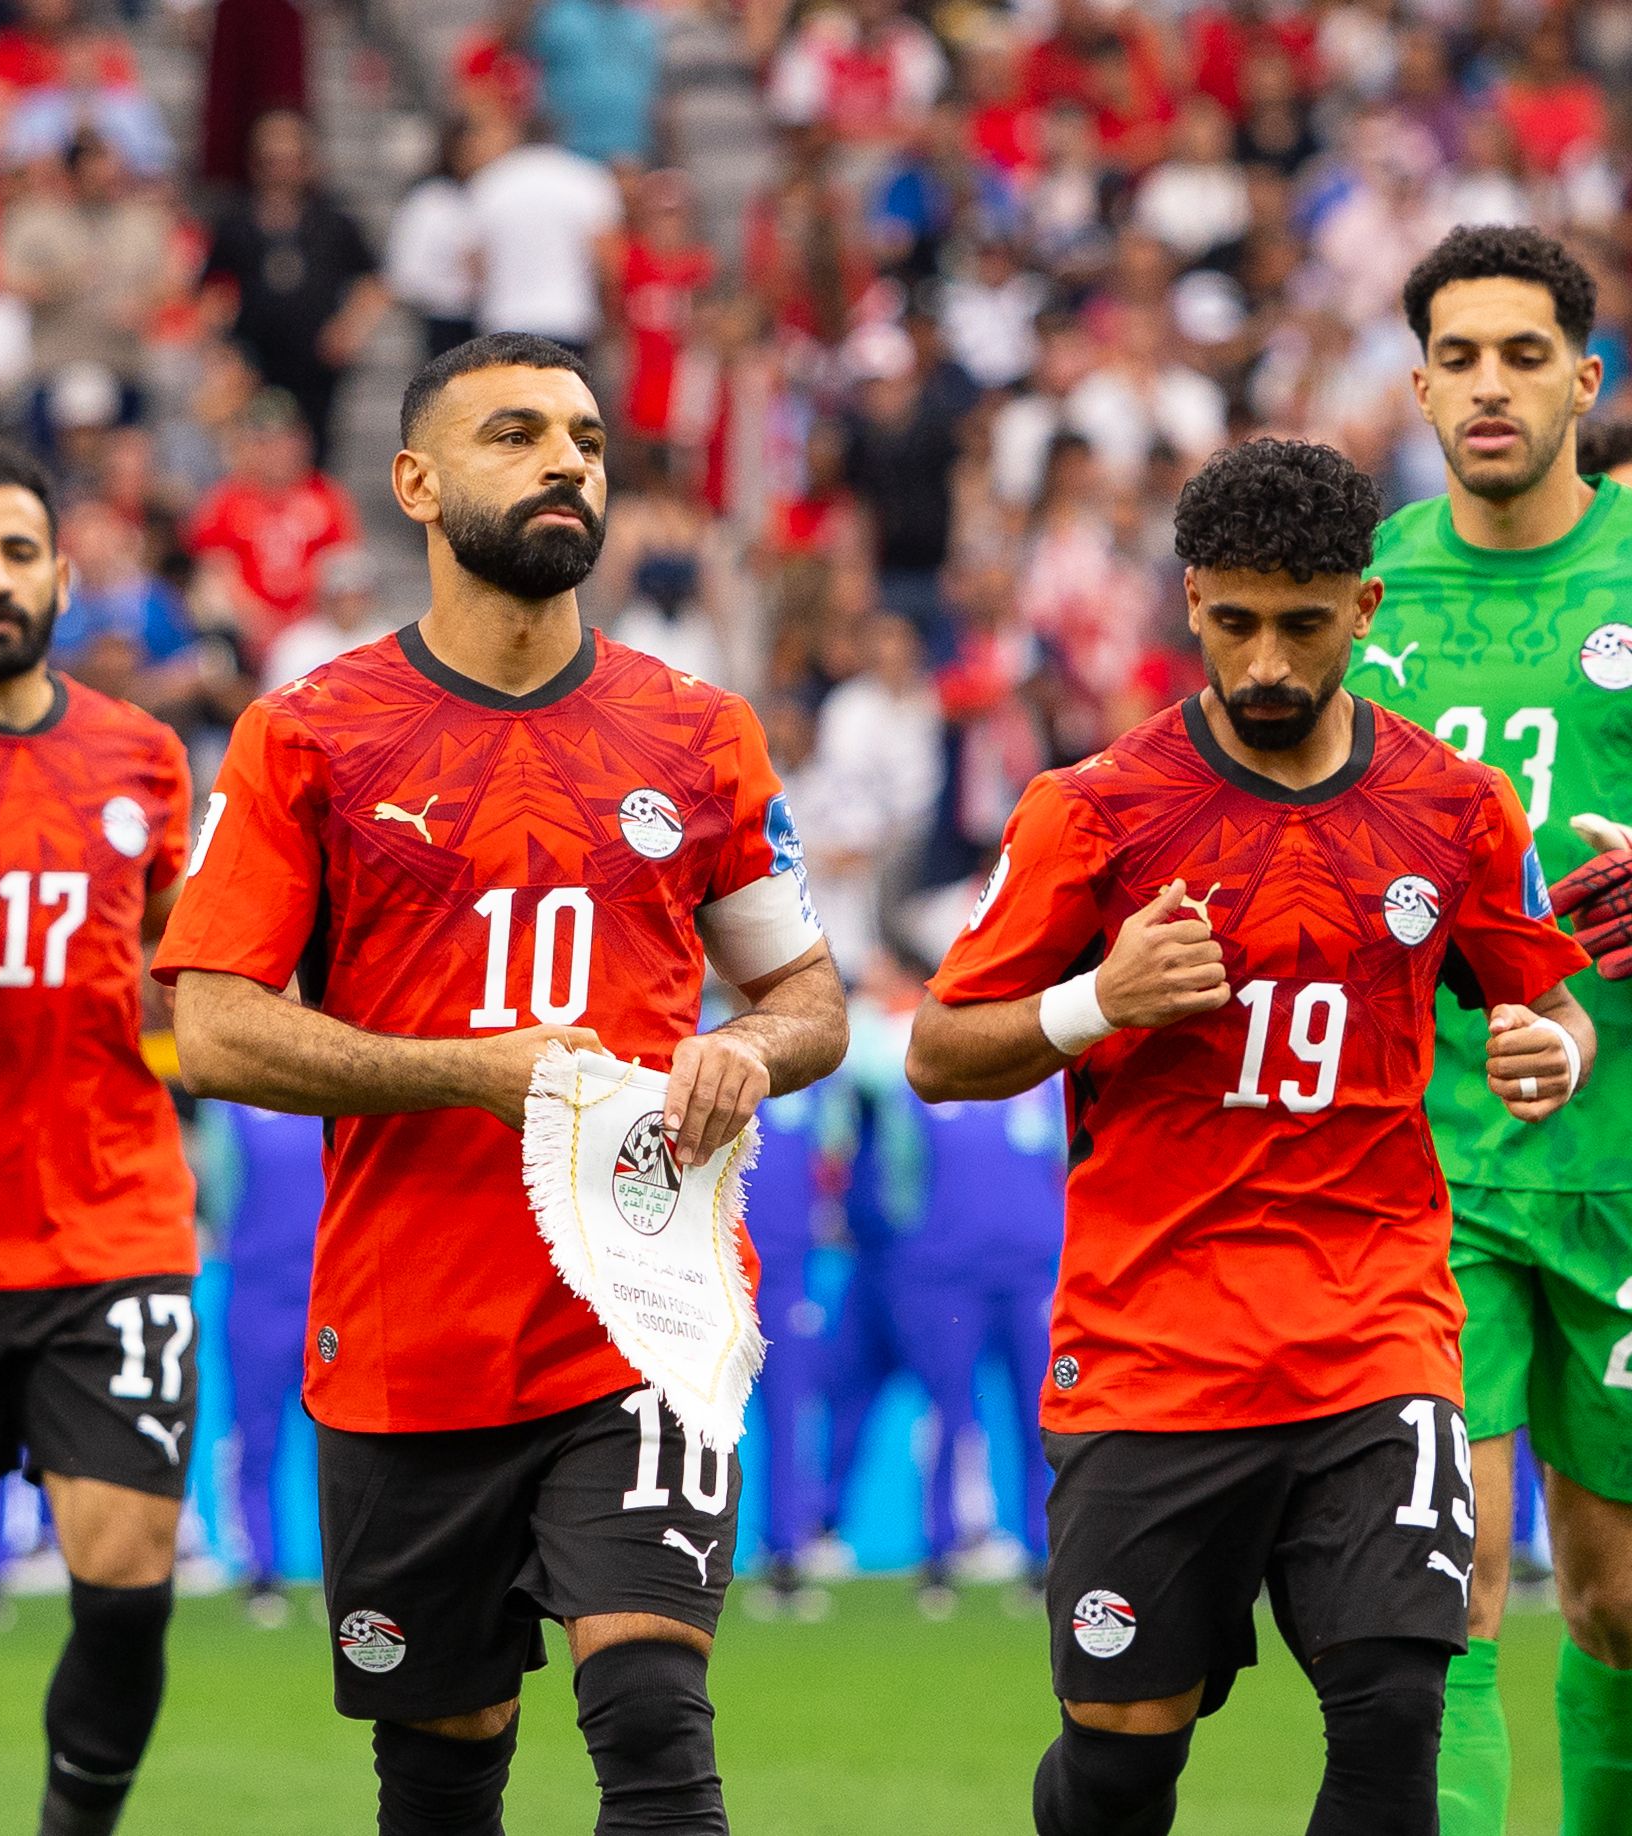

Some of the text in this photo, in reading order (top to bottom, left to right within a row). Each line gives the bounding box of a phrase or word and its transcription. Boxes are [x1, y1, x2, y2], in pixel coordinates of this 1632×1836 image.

[469, 886, 595, 1030] 10
[1223, 979, 1348, 1113] 19
[106, 1292, 195, 1402] 17
[613, 1282, 667, 1311] EGYPTIAN
[620, 1388, 729, 1516] 10
[1395, 1399, 1475, 1539] 19
